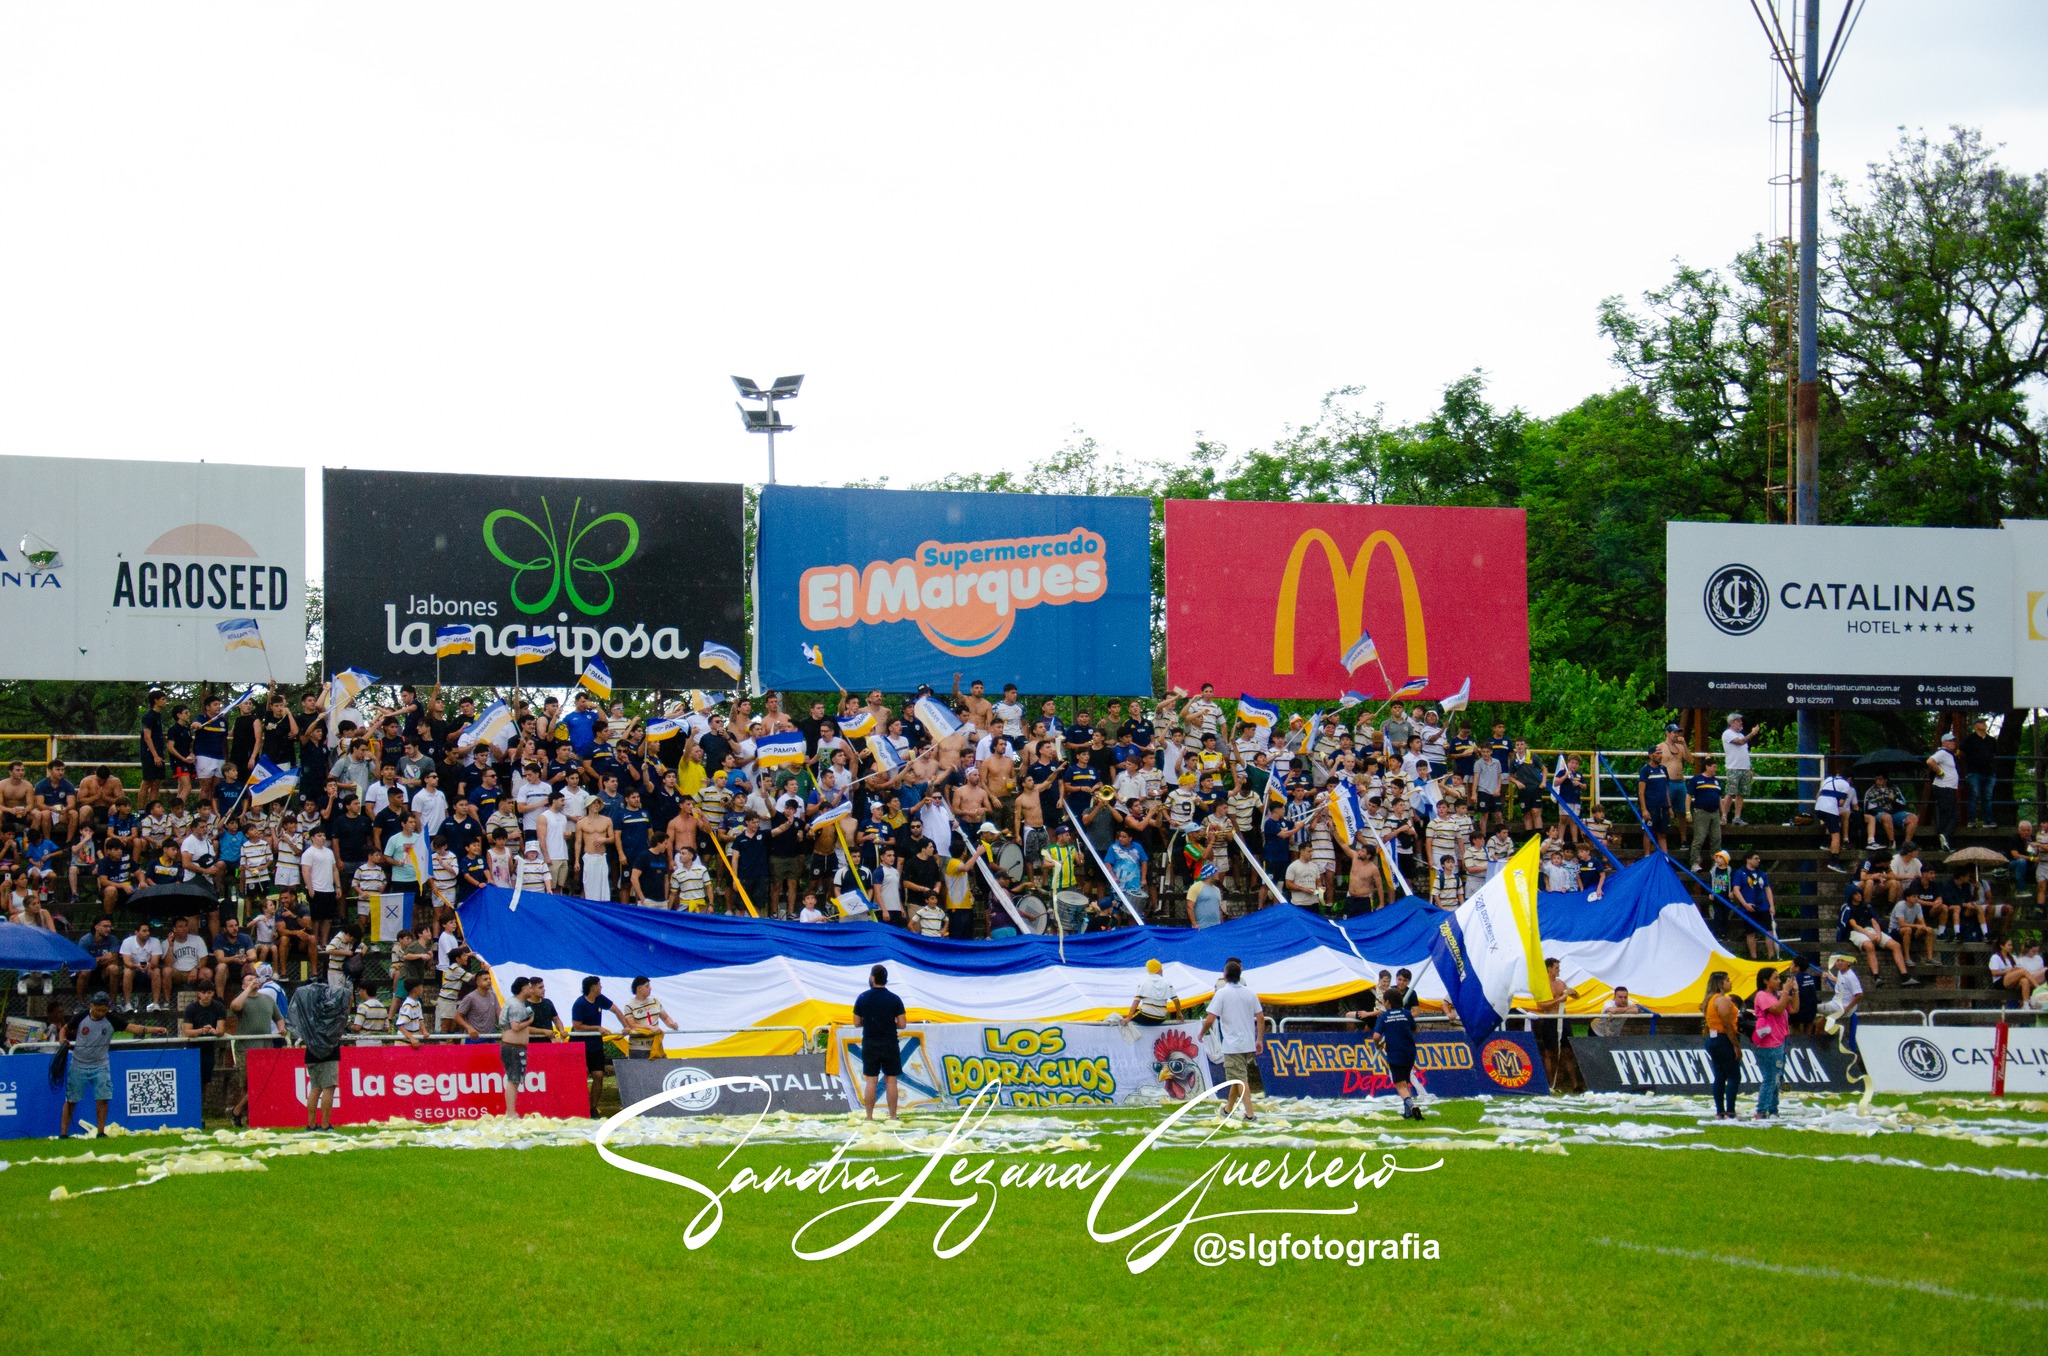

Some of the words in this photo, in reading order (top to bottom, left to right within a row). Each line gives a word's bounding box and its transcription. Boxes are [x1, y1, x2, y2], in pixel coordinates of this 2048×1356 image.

[924, 534, 1099, 571] Supermercado
[112, 561, 288, 611] AGROSEED
[808, 571, 854, 622] El
[866, 557, 1102, 616] Marques
[1780, 582, 1976, 613] CATALINAS
[405, 594, 498, 617] Jabones
[1847, 620, 1900, 634] HOTEL
[1716, 682, 1767, 691] catalinas.hotel
[1794, 683, 1900, 692] hotelcatalinastucuman.com.ar
[1925, 685, 1936, 693] Av.
[1937, 685, 1961, 693] Soldati
[1915, 697, 1923, 706] S.
[1924, 698, 1933, 706] M.
[1934, 698, 1944, 706] de
[1945, 698, 1979, 706] Tucumán
[1182, 801, 1194, 816] 9
[1346, 815, 1355, 839] PAMPA
[983, 1026, 1067, 1057] LOS
[1266, 1038, 1474, 1076] MARCANONIO
[1609, 1049, 1716, 1086] FERNET
[1740, 1047, 1831, 1083] RNCA
[351, 1068, 386, 1097] la
[393, 1071, 546, 1102] seguna
[942, 1054, 1117, 1097] BORRACHOS
[1488, 1069, 1531, 1087] DEPORTES
[414, 1106, 488, 1119] SEGUROS
